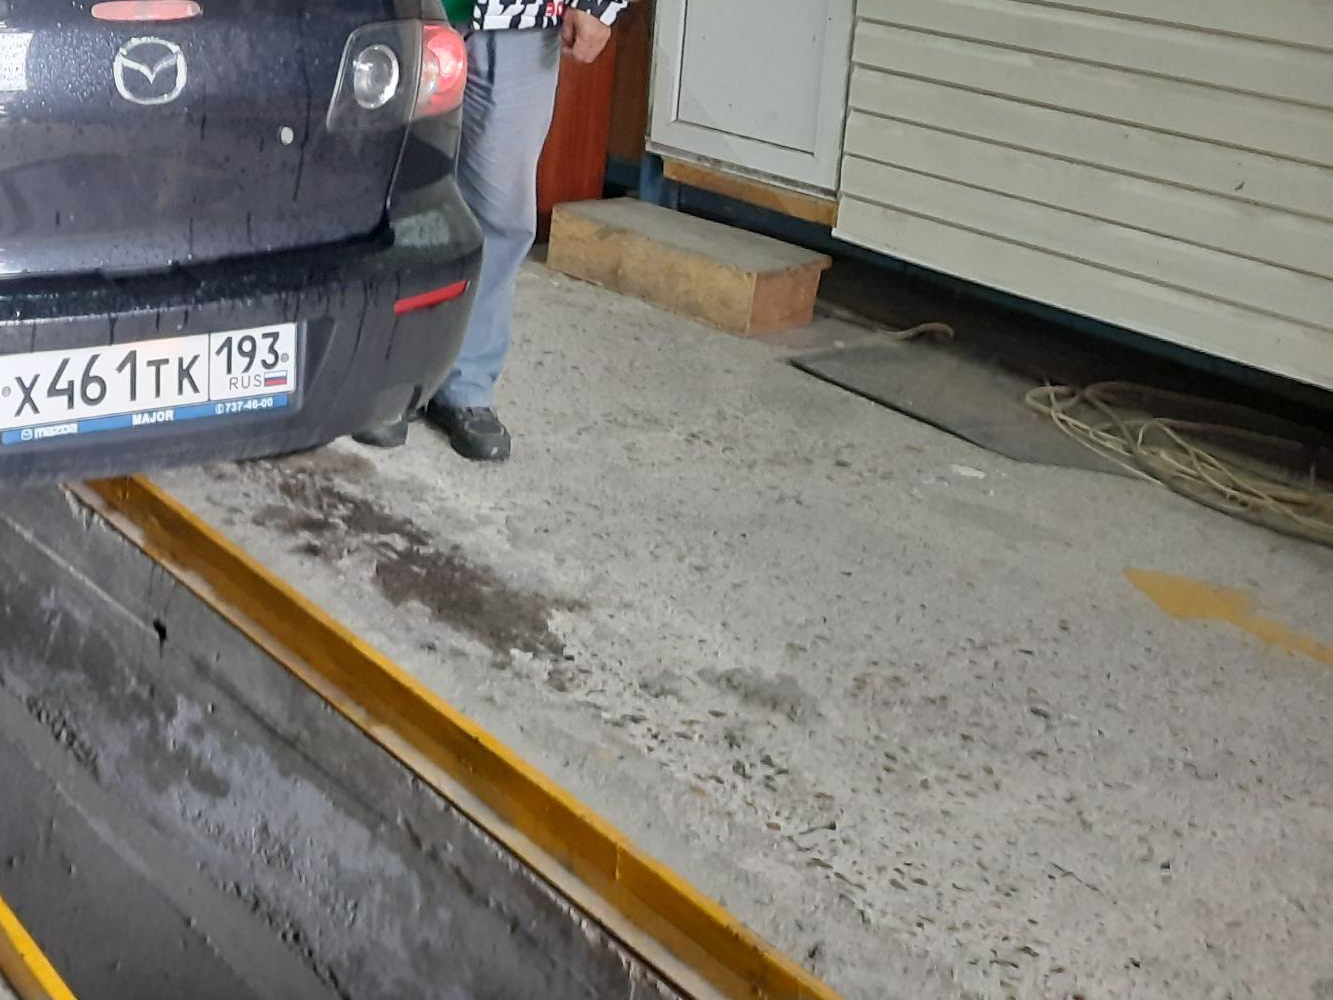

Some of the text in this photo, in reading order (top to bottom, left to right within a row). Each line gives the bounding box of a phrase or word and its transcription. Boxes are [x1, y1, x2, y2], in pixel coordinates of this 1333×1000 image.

[215, 331, 280, 375] 193
[229, 373, 263, 391] RUS
[132, 410, 174, 426] MAJOR
